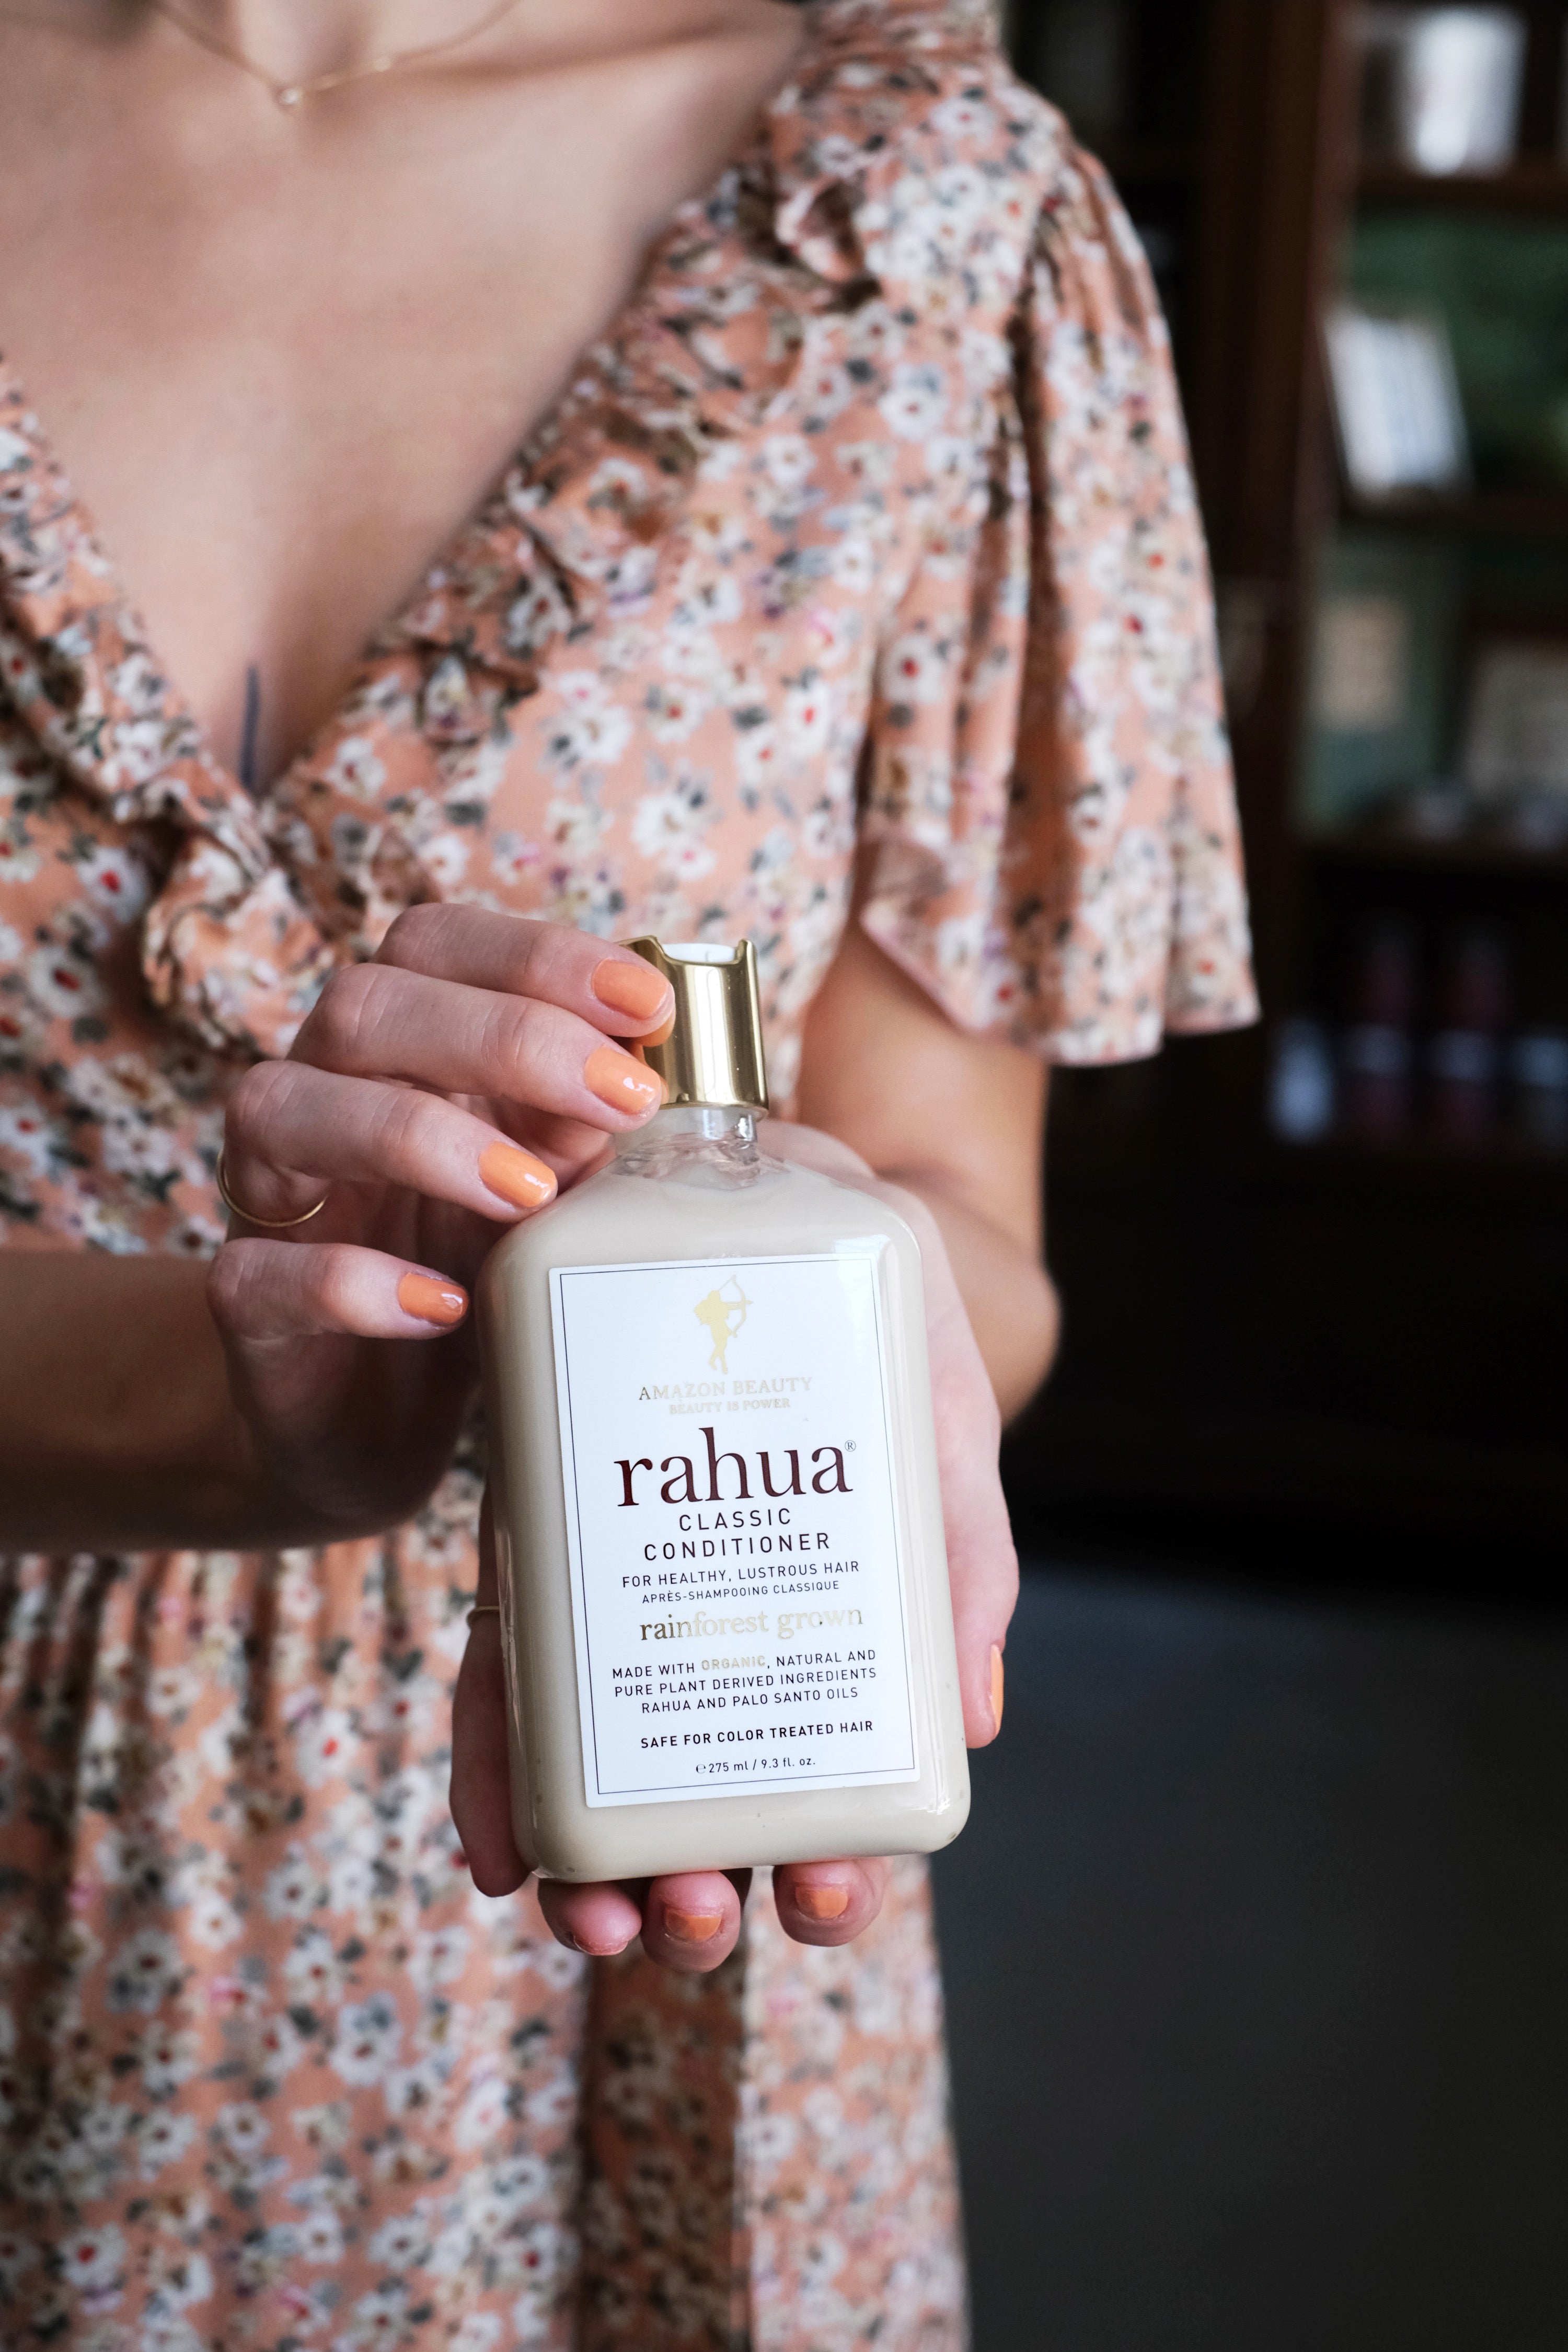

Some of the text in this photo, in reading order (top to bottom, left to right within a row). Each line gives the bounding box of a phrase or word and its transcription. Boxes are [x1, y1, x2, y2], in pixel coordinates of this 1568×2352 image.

[639, 1377, 812, 1400] AMAZON BEAUTY
[669, 1398, 790, 1414] BEAUTY IS POWER
[679, 1508, 790, 1531] CLASSIC
[644, 1532, 829, 1561] CONDITIONER
[622, 1561, 859, 1588] FOR HEALTHY, LUSTROUS HAIR
[642, 1581, 839, 1604] APRÈS-SHAMPOOING CLASSIQUE
[639, 1609, 863, 1641] rainforest grown
[613, 1650, 875, 1679] MADE WITH ORGANIC, NATURAL AND
[615, 1667, 877, 1697] PURE PLANT DERIVED INGREDIENTS
[641, 1687, 858, 1714] RAHUA AND PALO SANTO OILS
[641, 1721, 873, 1748] SAFE FOR COLOR TREATED HAIR
[733, 1760, 748, 1771] ml
[761, 1758, 779, 1769] 9.3
